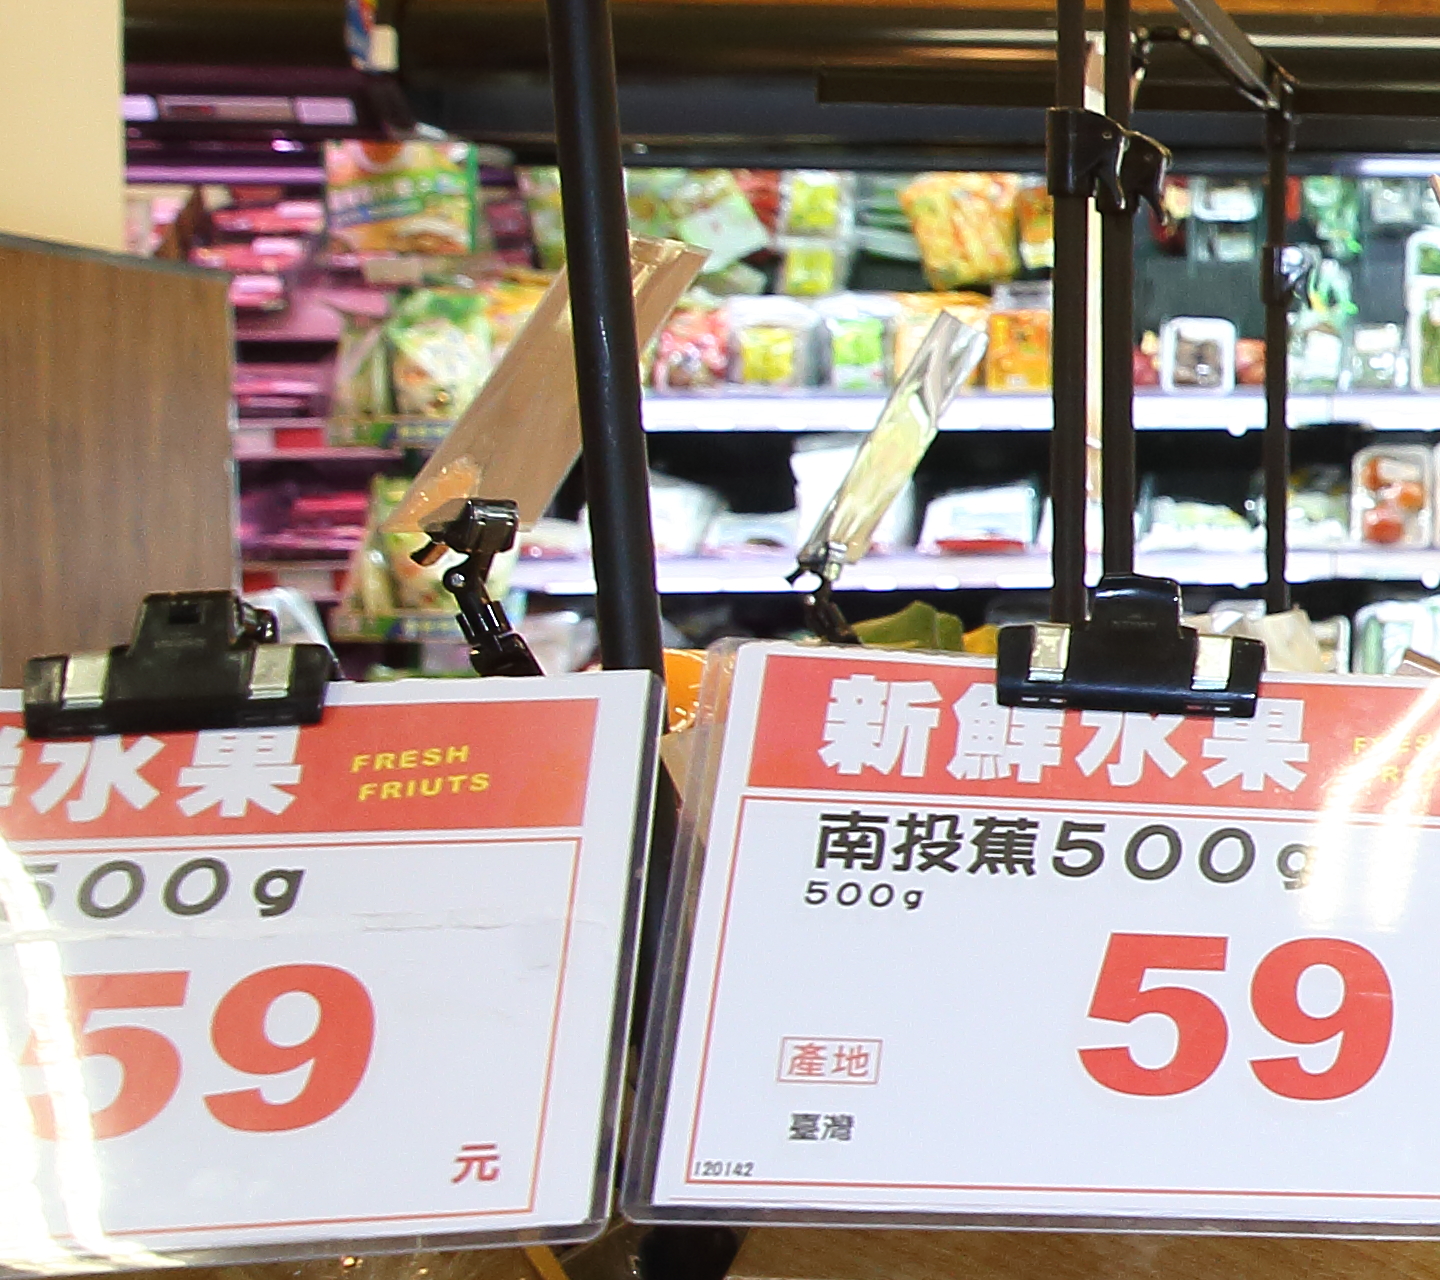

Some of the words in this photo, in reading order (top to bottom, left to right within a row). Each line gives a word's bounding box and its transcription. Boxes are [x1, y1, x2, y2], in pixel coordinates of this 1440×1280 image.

[815, 672, 1313, 793] 新鮮水果
[0, 725, 303, 824] 水果
[350, 743, 472, 775] FRESH
[358, 771, 492, 804] FRIUTS
[814, 810, 1316, 891] 南投蕉500g
[803, 878, 925, 913] 500g
[1077, 931, 1394, 1102] 59
[18, 962, 378, 1142] 59
[785, 1039, 872, 1082] 產地
[787, 1112, 855, 1143] 臺灣
[450, 1142, 501, 1186] 元
[692, 1160, 755, 1179] 120142
